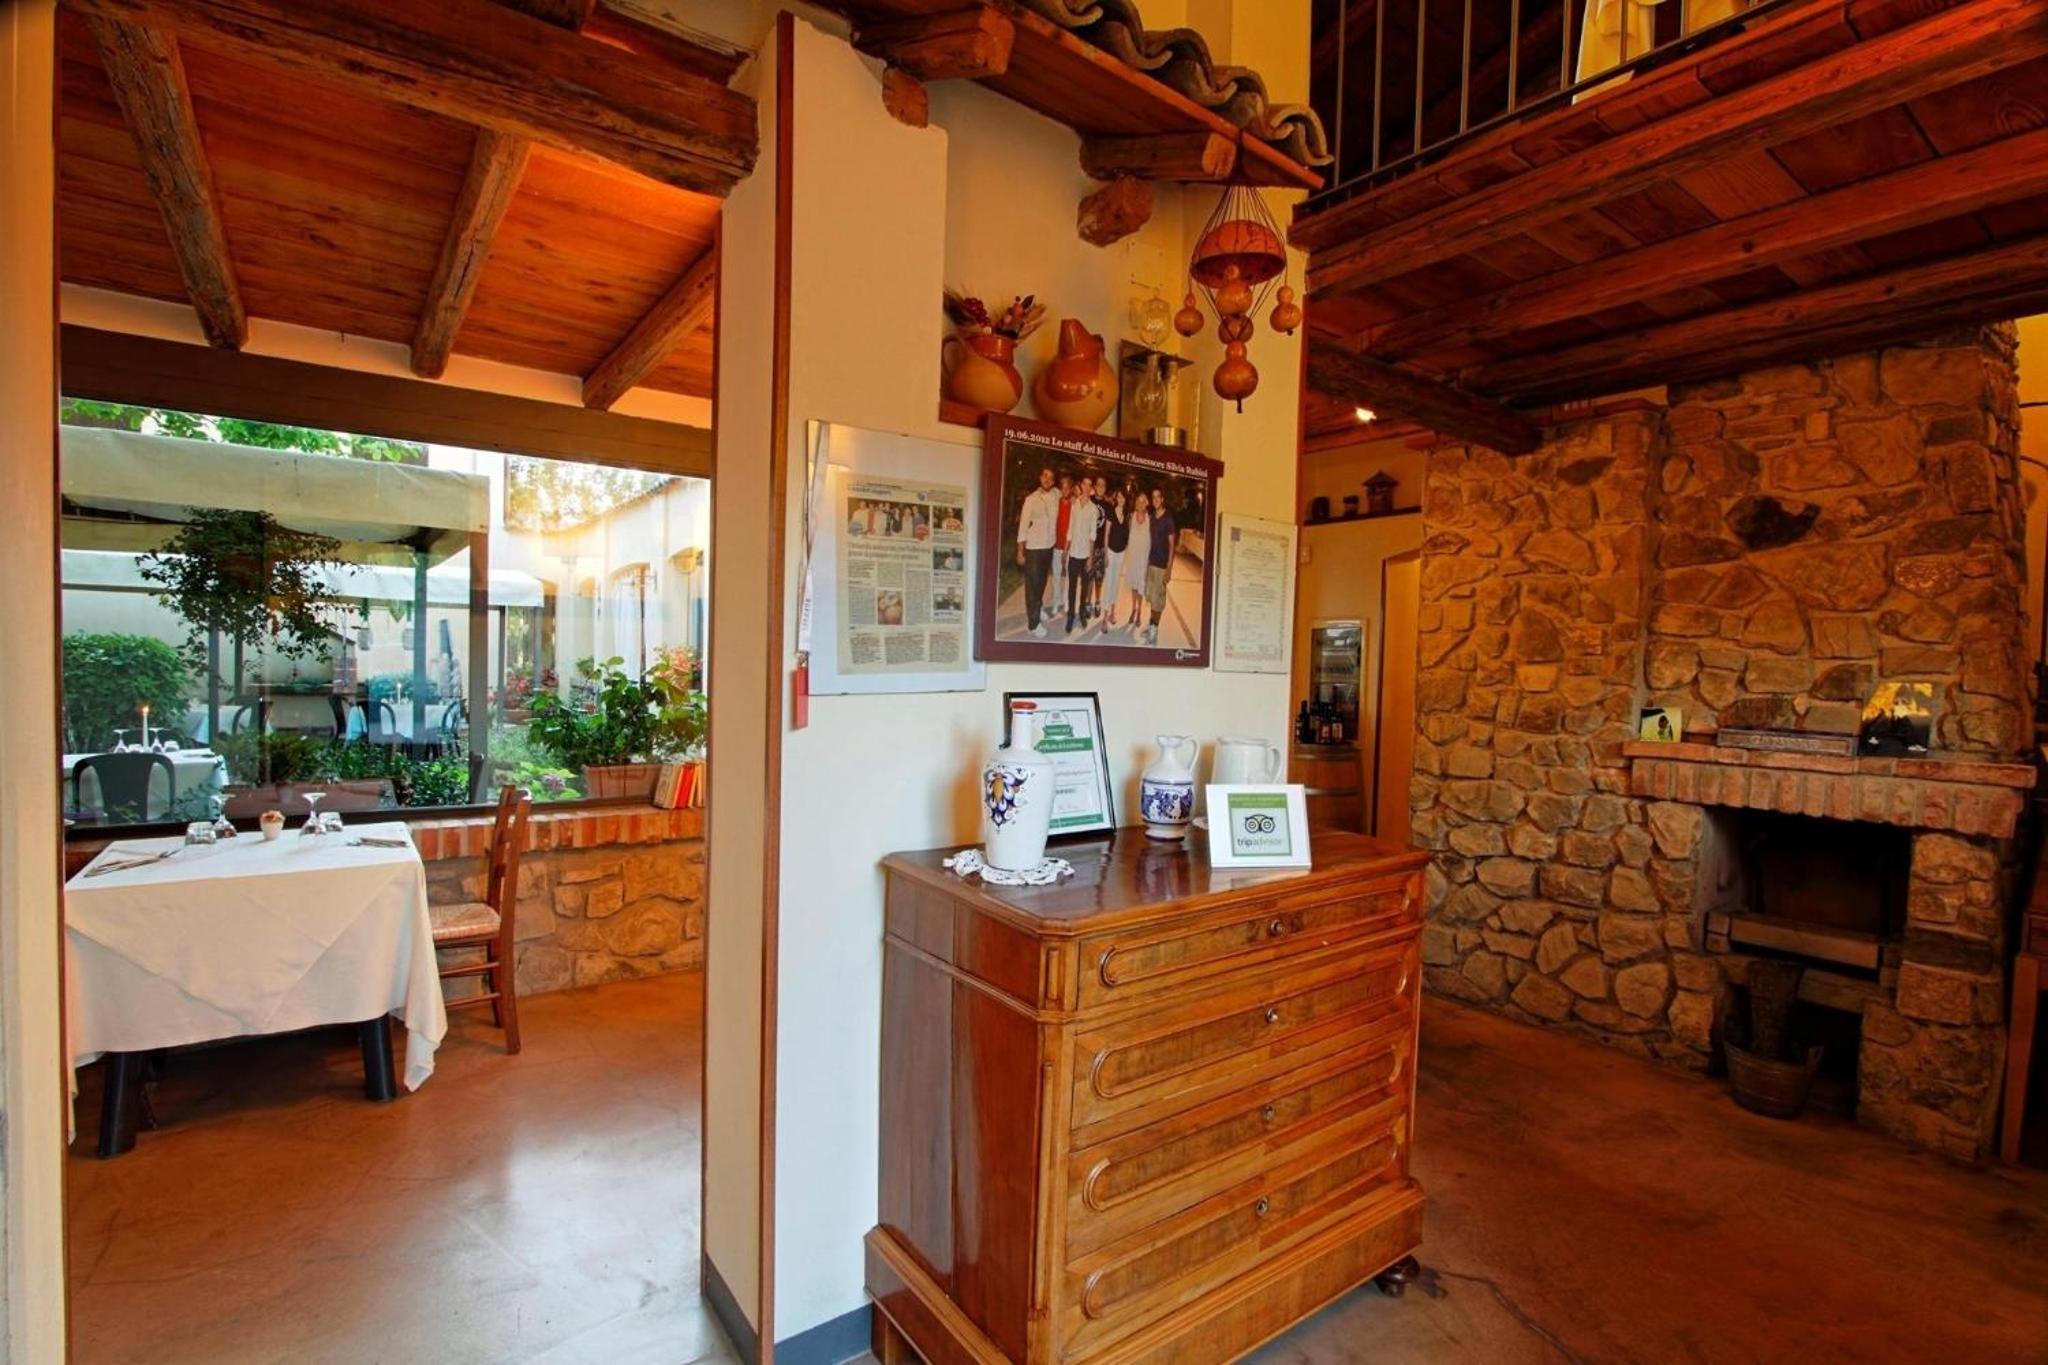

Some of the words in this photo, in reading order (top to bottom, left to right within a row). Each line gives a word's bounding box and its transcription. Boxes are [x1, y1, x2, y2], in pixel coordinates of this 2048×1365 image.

[1051, 436, 1063, 447] Lo
[1064, 440, 1083, 452] staff
[1097, 445, 1120, 458] Relais
